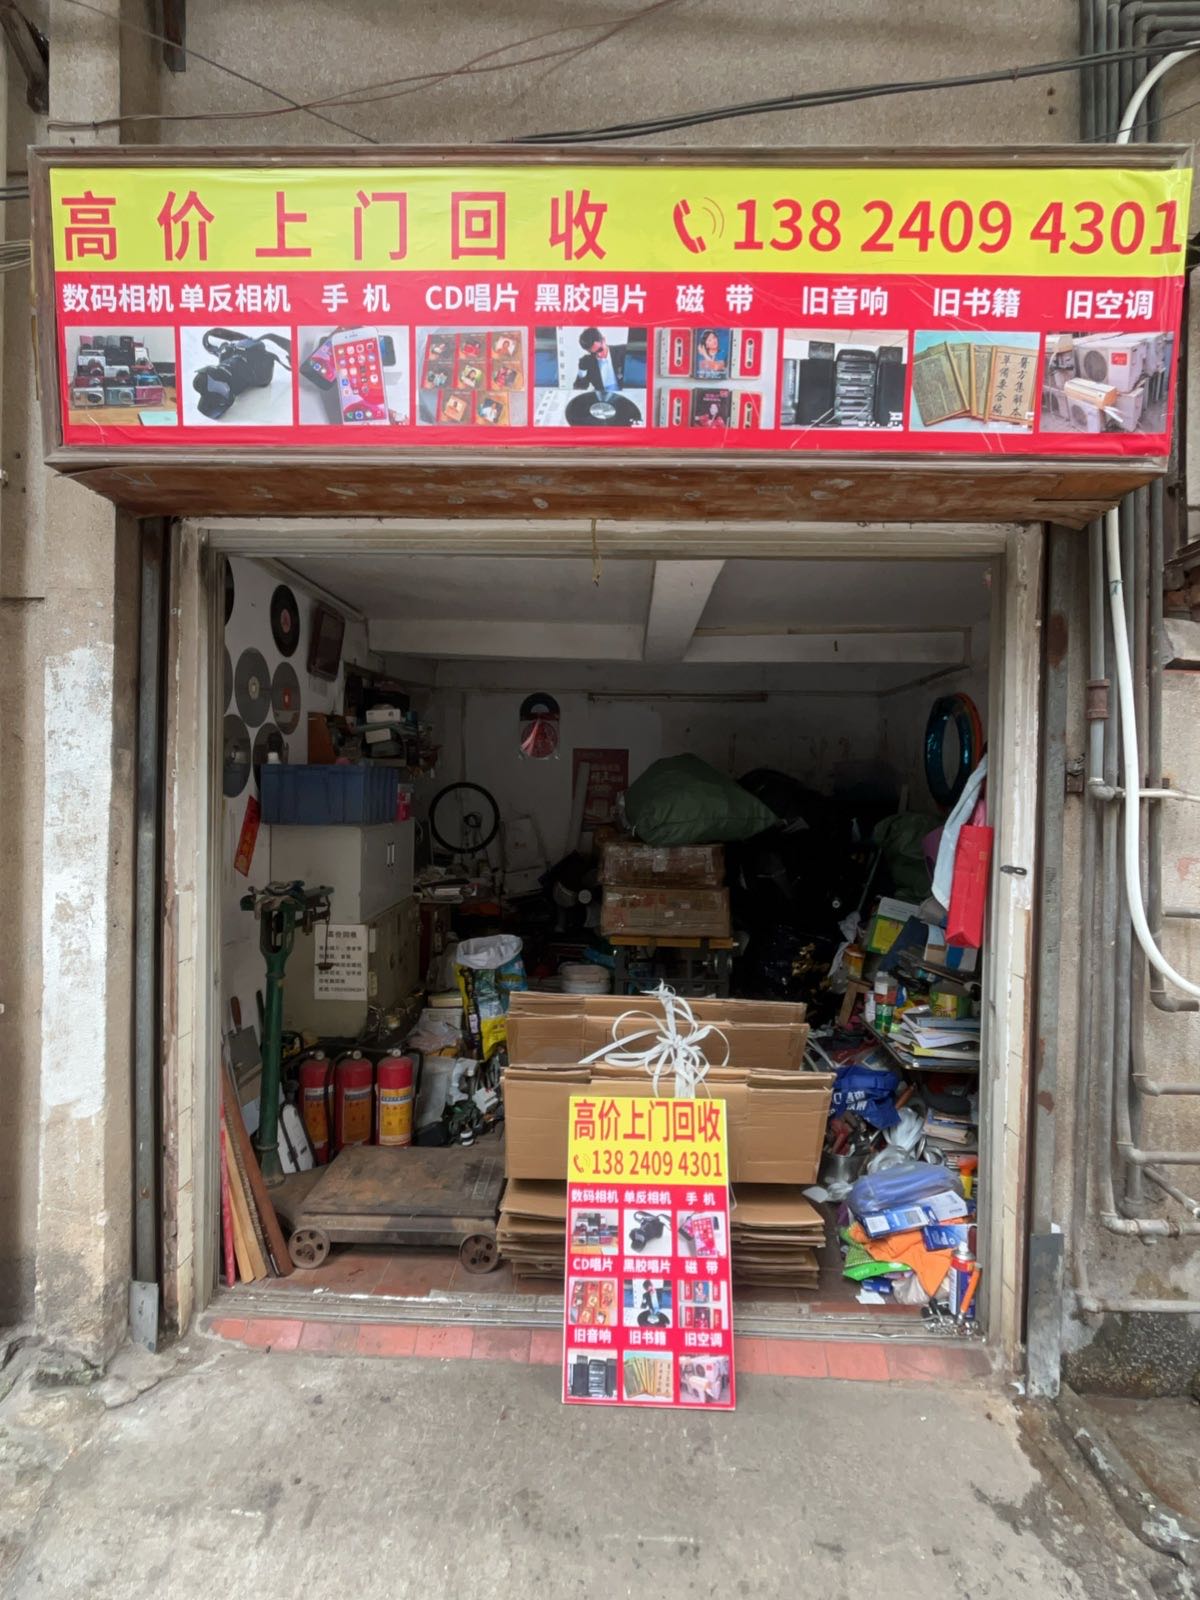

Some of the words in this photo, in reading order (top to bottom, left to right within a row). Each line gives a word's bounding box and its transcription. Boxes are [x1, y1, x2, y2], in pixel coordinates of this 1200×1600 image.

[61, 189, 608, 262] 高价上门回收
[733, 198, 842, 253] 138
[860, 199, 1013, 253] 2409
[1030, 199, 1183, 256] 4301
[62, 283, 175, 313] 数码相机
[179, 283, 291, 313] 单反相机
[321, 283, 391, 313] 手机
[425, 283, 519, 313] CD唱片
[534, 284, 647, 314] 黑胶唱片
[676, 284, 754, 314] 磁带
[802, 286, 889, 317] 旧音响
[933, 287, 1021, 318] 旧书籍
[1065, 288, 1155, 320] 旧空调
[573, 1099, 721, 1143] 高价上门回收
[592, 1150, 624, 1175] 138
[629, 1150, 673, 1176] 2409
[678, 1151, 723, 1177] 4301
[571, 1188, 619, 1204] 数码相机
[624, 1190, 672, 1205] 单反相机
[572, 1257, 613, 1272] CD唱片
[623, 1259, 671, 1274] 黑胶唱片
[574, 1328, 611, 1344] 旧音响
[629, 1329, 667, 1346] 旧书籍
[685, 1331, 723, 1348] 旧空调
